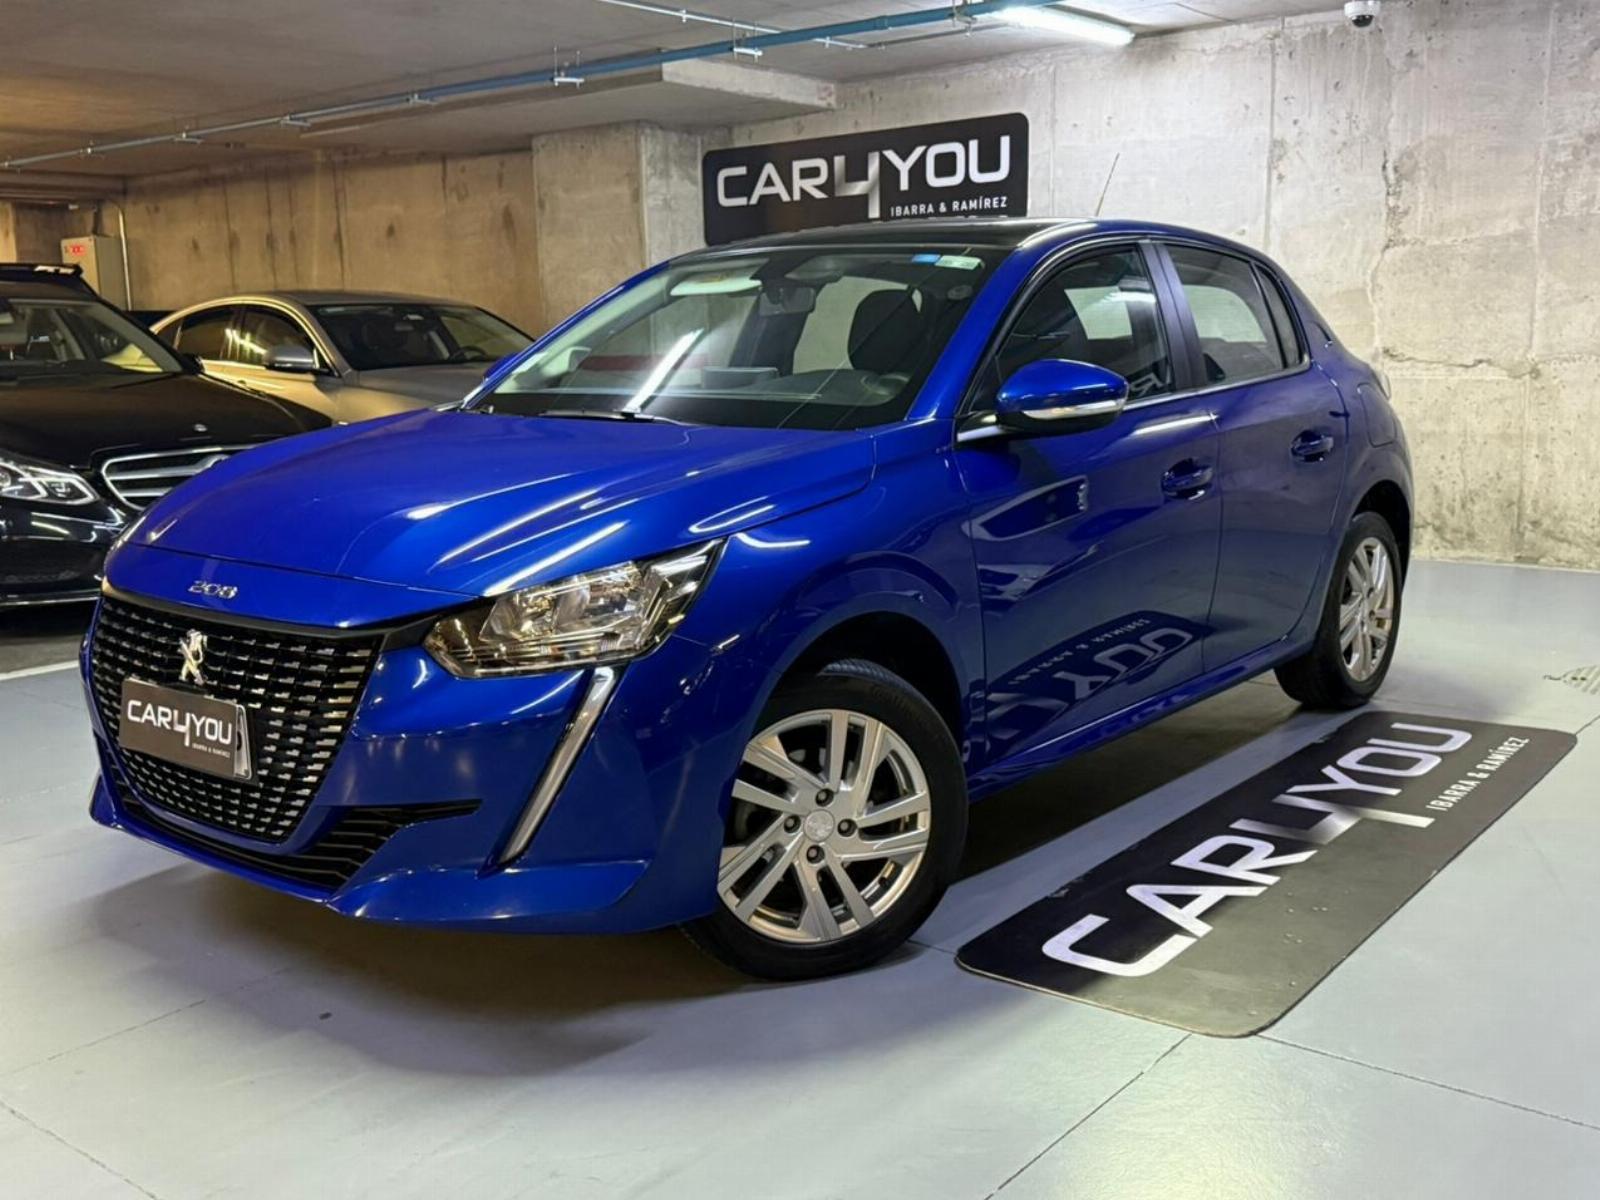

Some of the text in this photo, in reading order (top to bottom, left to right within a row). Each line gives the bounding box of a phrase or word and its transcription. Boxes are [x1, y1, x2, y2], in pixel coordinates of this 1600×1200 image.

[716, 135, 1010, 219] CAR4YOU
[890, 196, 1008, 217] IBARRA & RAMÍREZ
[188, 580, 238, 599] 208
[127, 699, 232, 747] CAR4YOU
[1425, 780, 1480, 811] IBARRA
[1476, 736, 1530, 771] RAMÍREZ
[1041, 722, 1472, 977] CAR4YOU
